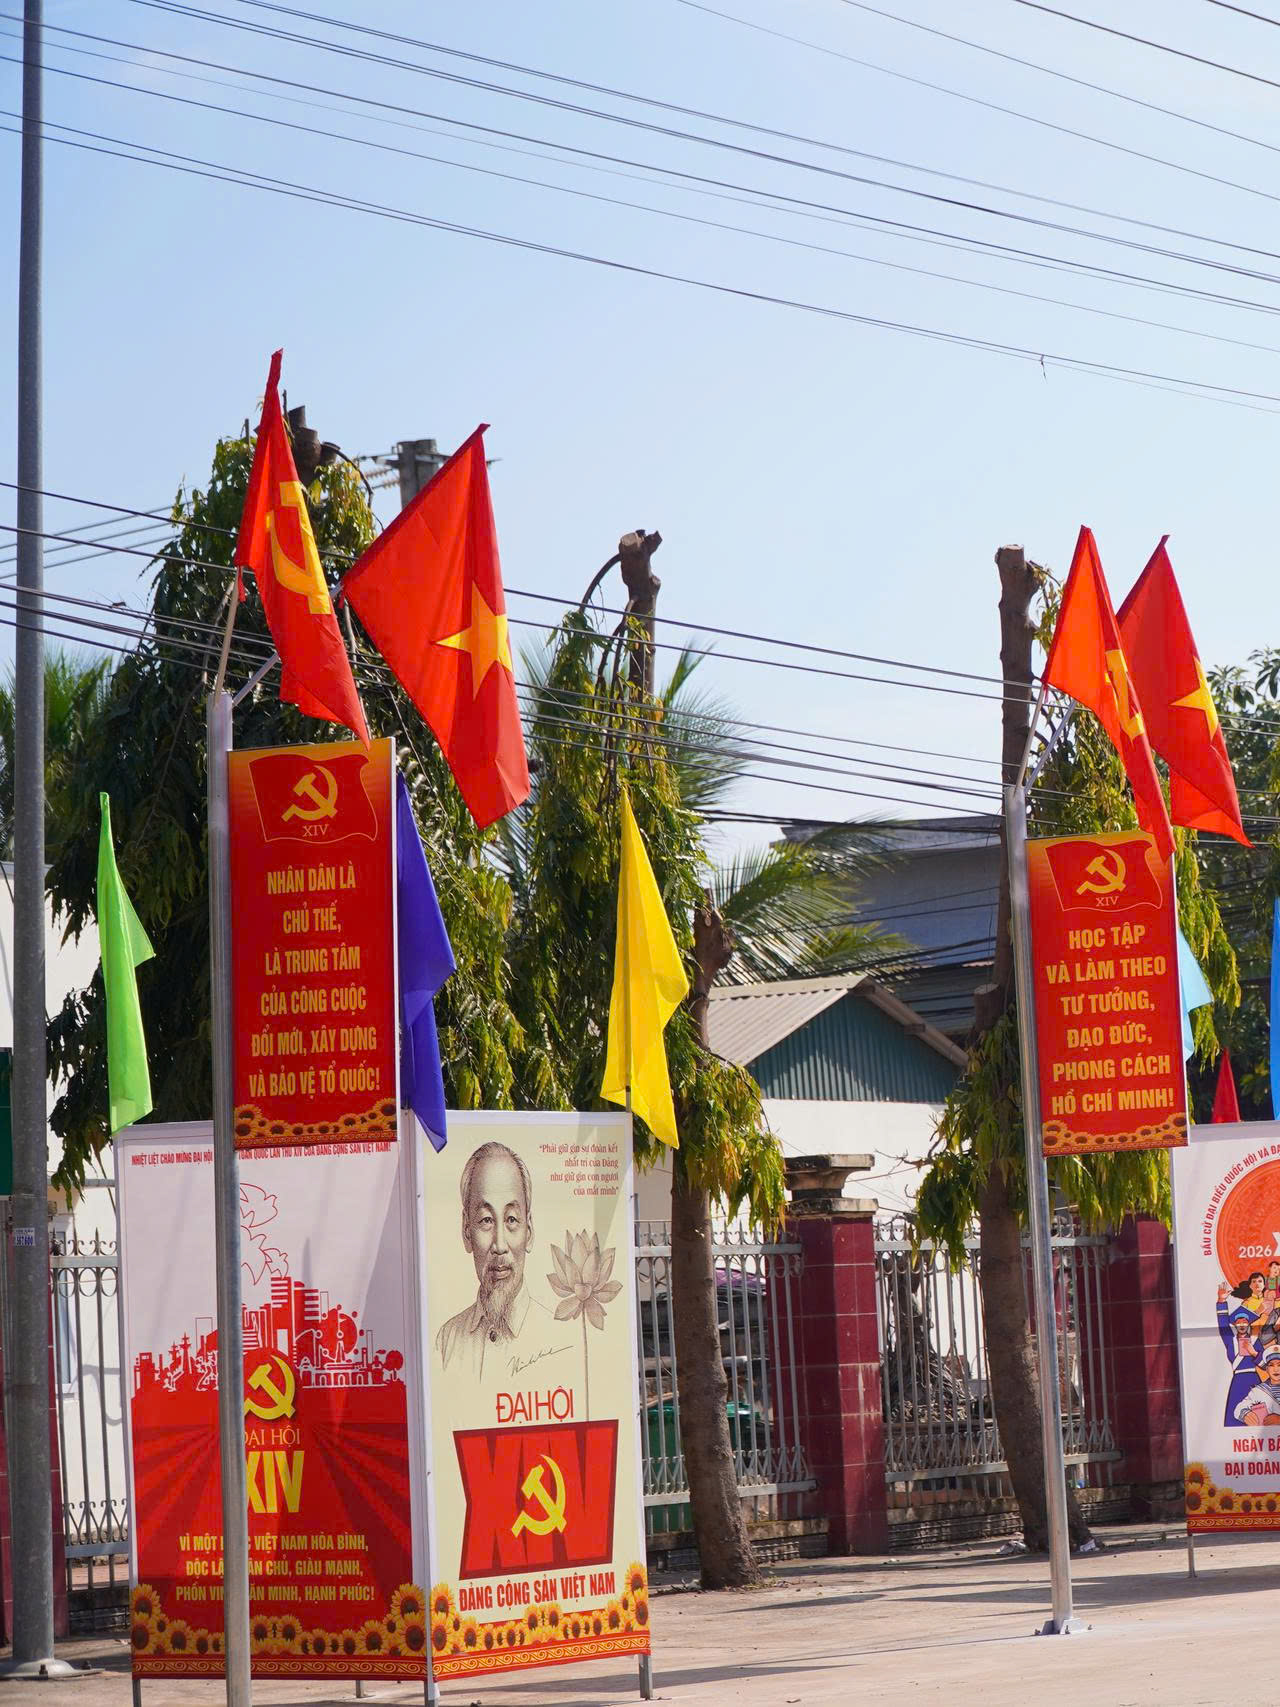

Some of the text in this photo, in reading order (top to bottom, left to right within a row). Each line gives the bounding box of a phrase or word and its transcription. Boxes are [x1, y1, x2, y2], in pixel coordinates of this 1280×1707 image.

[302, 824, 329, 837] XIV
[267, 860, 356, 895] NHÂN DÂN LÀ
[1095, 896, 1119, 907] XIV
[283, 901, 309, 934] CHỦ
[1068, 921, 1146, 952] HỌC TẬP
[265, 942, 361, 976] LÀ TRUNG TÂM
[1046, 956, 1167, 985] VÀ LÀM THEO
[261, 982, 367, 1016] CỦA CÔNG CUỘC
[1060, 986, 1155, 1016] TƯ TƯỞNG,
[251, 1024, 377, 1057] ĐỔI MỚI, XÂY DỰNG
[1066, 1022, 1153, 1052] ĐẠO ĐỨC,
[249, 1060, 380, 1100] VÀ BẢO VỆ TỔ QUỐC!
[1053, 1051, 1171, 1083] PHONG CÁCH
[1052, 1087, 1175, 1116] HỒ CHÍ MINH!
[1238, 1245, 1273, 1259] 2026
[495, 1385, 574, 1424] ĐẠI HỘI
[271, 1423, 301, 1447] HỘI
[1233, 1435, 1265, 1453] NGÀY
[1224, 1462, 1245, 1479] ĐẠI
[1248, 1459, 1280, 1476] ĐOÀN
[179, 1532, 191, 1551] VÌ
[193, 1532, 218, 1554] MỘT
[254, 1532, 278, 1554] VIỆT
[281, 1535, 308, 1550] NAM
[337, 1531, 369, 1551] BÌNH,
[186, 1557, 209, 1579] ĐỘC
[295, 1556, 322, 1575] GIÀU
[325, 1560, 364, 1579] MẠNH,
[268, 1582, 375, 1604] MINH, HẠNH PHÚC!
[459, 1571, 616, 1612] ĐẢNG CỘNG SẢN VIỆT NAM
